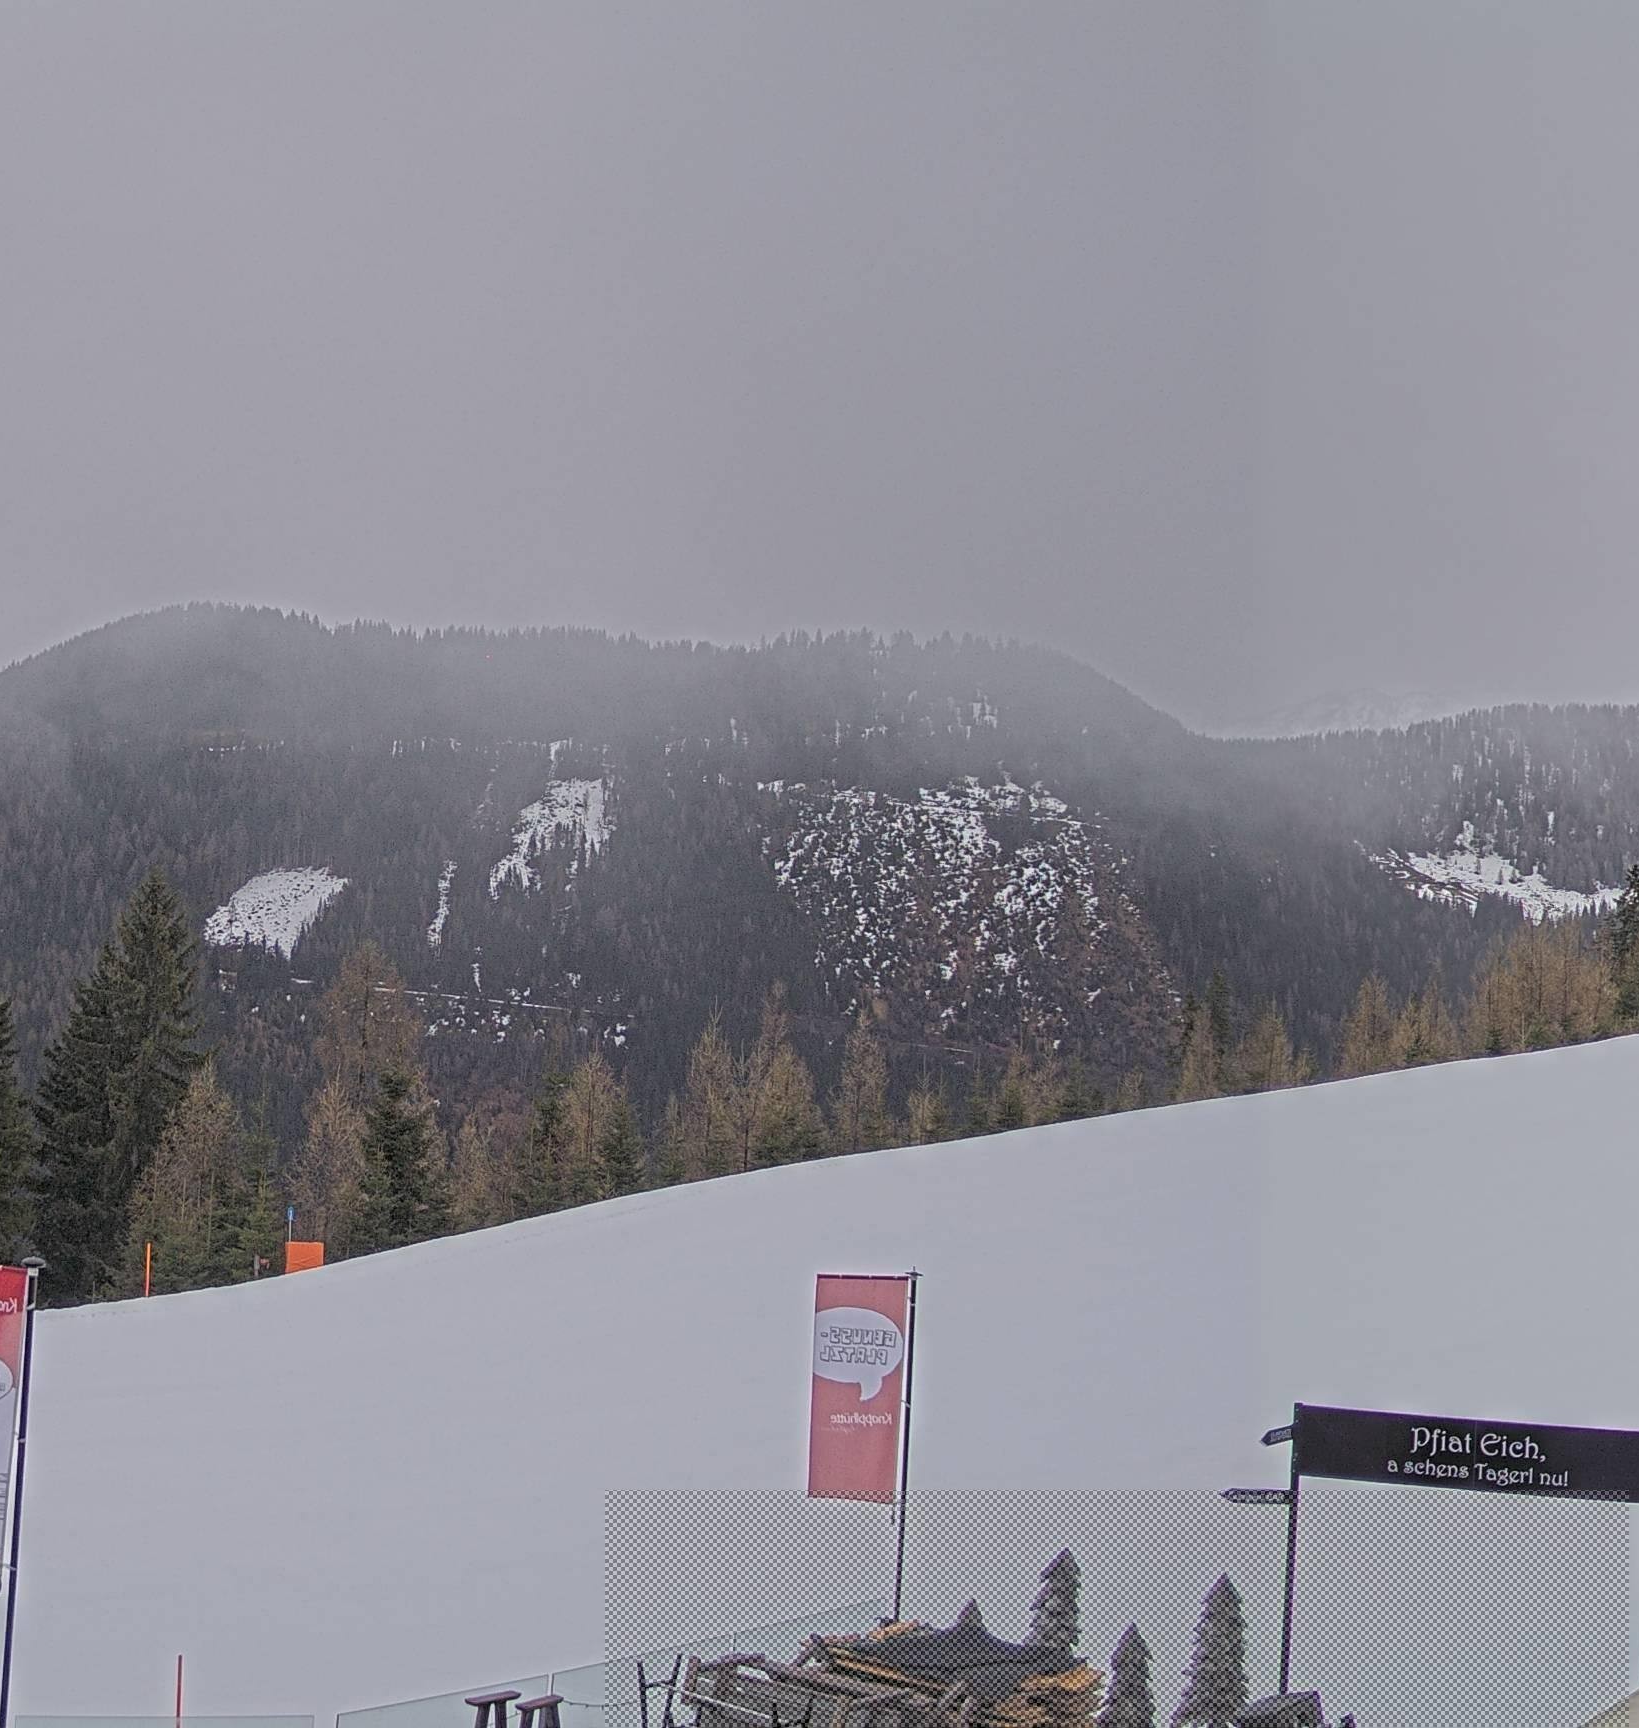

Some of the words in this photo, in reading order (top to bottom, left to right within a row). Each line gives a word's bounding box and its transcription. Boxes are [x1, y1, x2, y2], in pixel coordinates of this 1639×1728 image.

[1410, 1427, 1473, 1456] Pfiat
[1480, 1433, 1547, 1463] Eich,
[1387, 1459, 1398, 1473] a
[1403, 1459, 1469, 1479] schens
[1474, 1463, 1534, 1487] Tagerl
[1539, 1470, 1569, 1487] nu!
